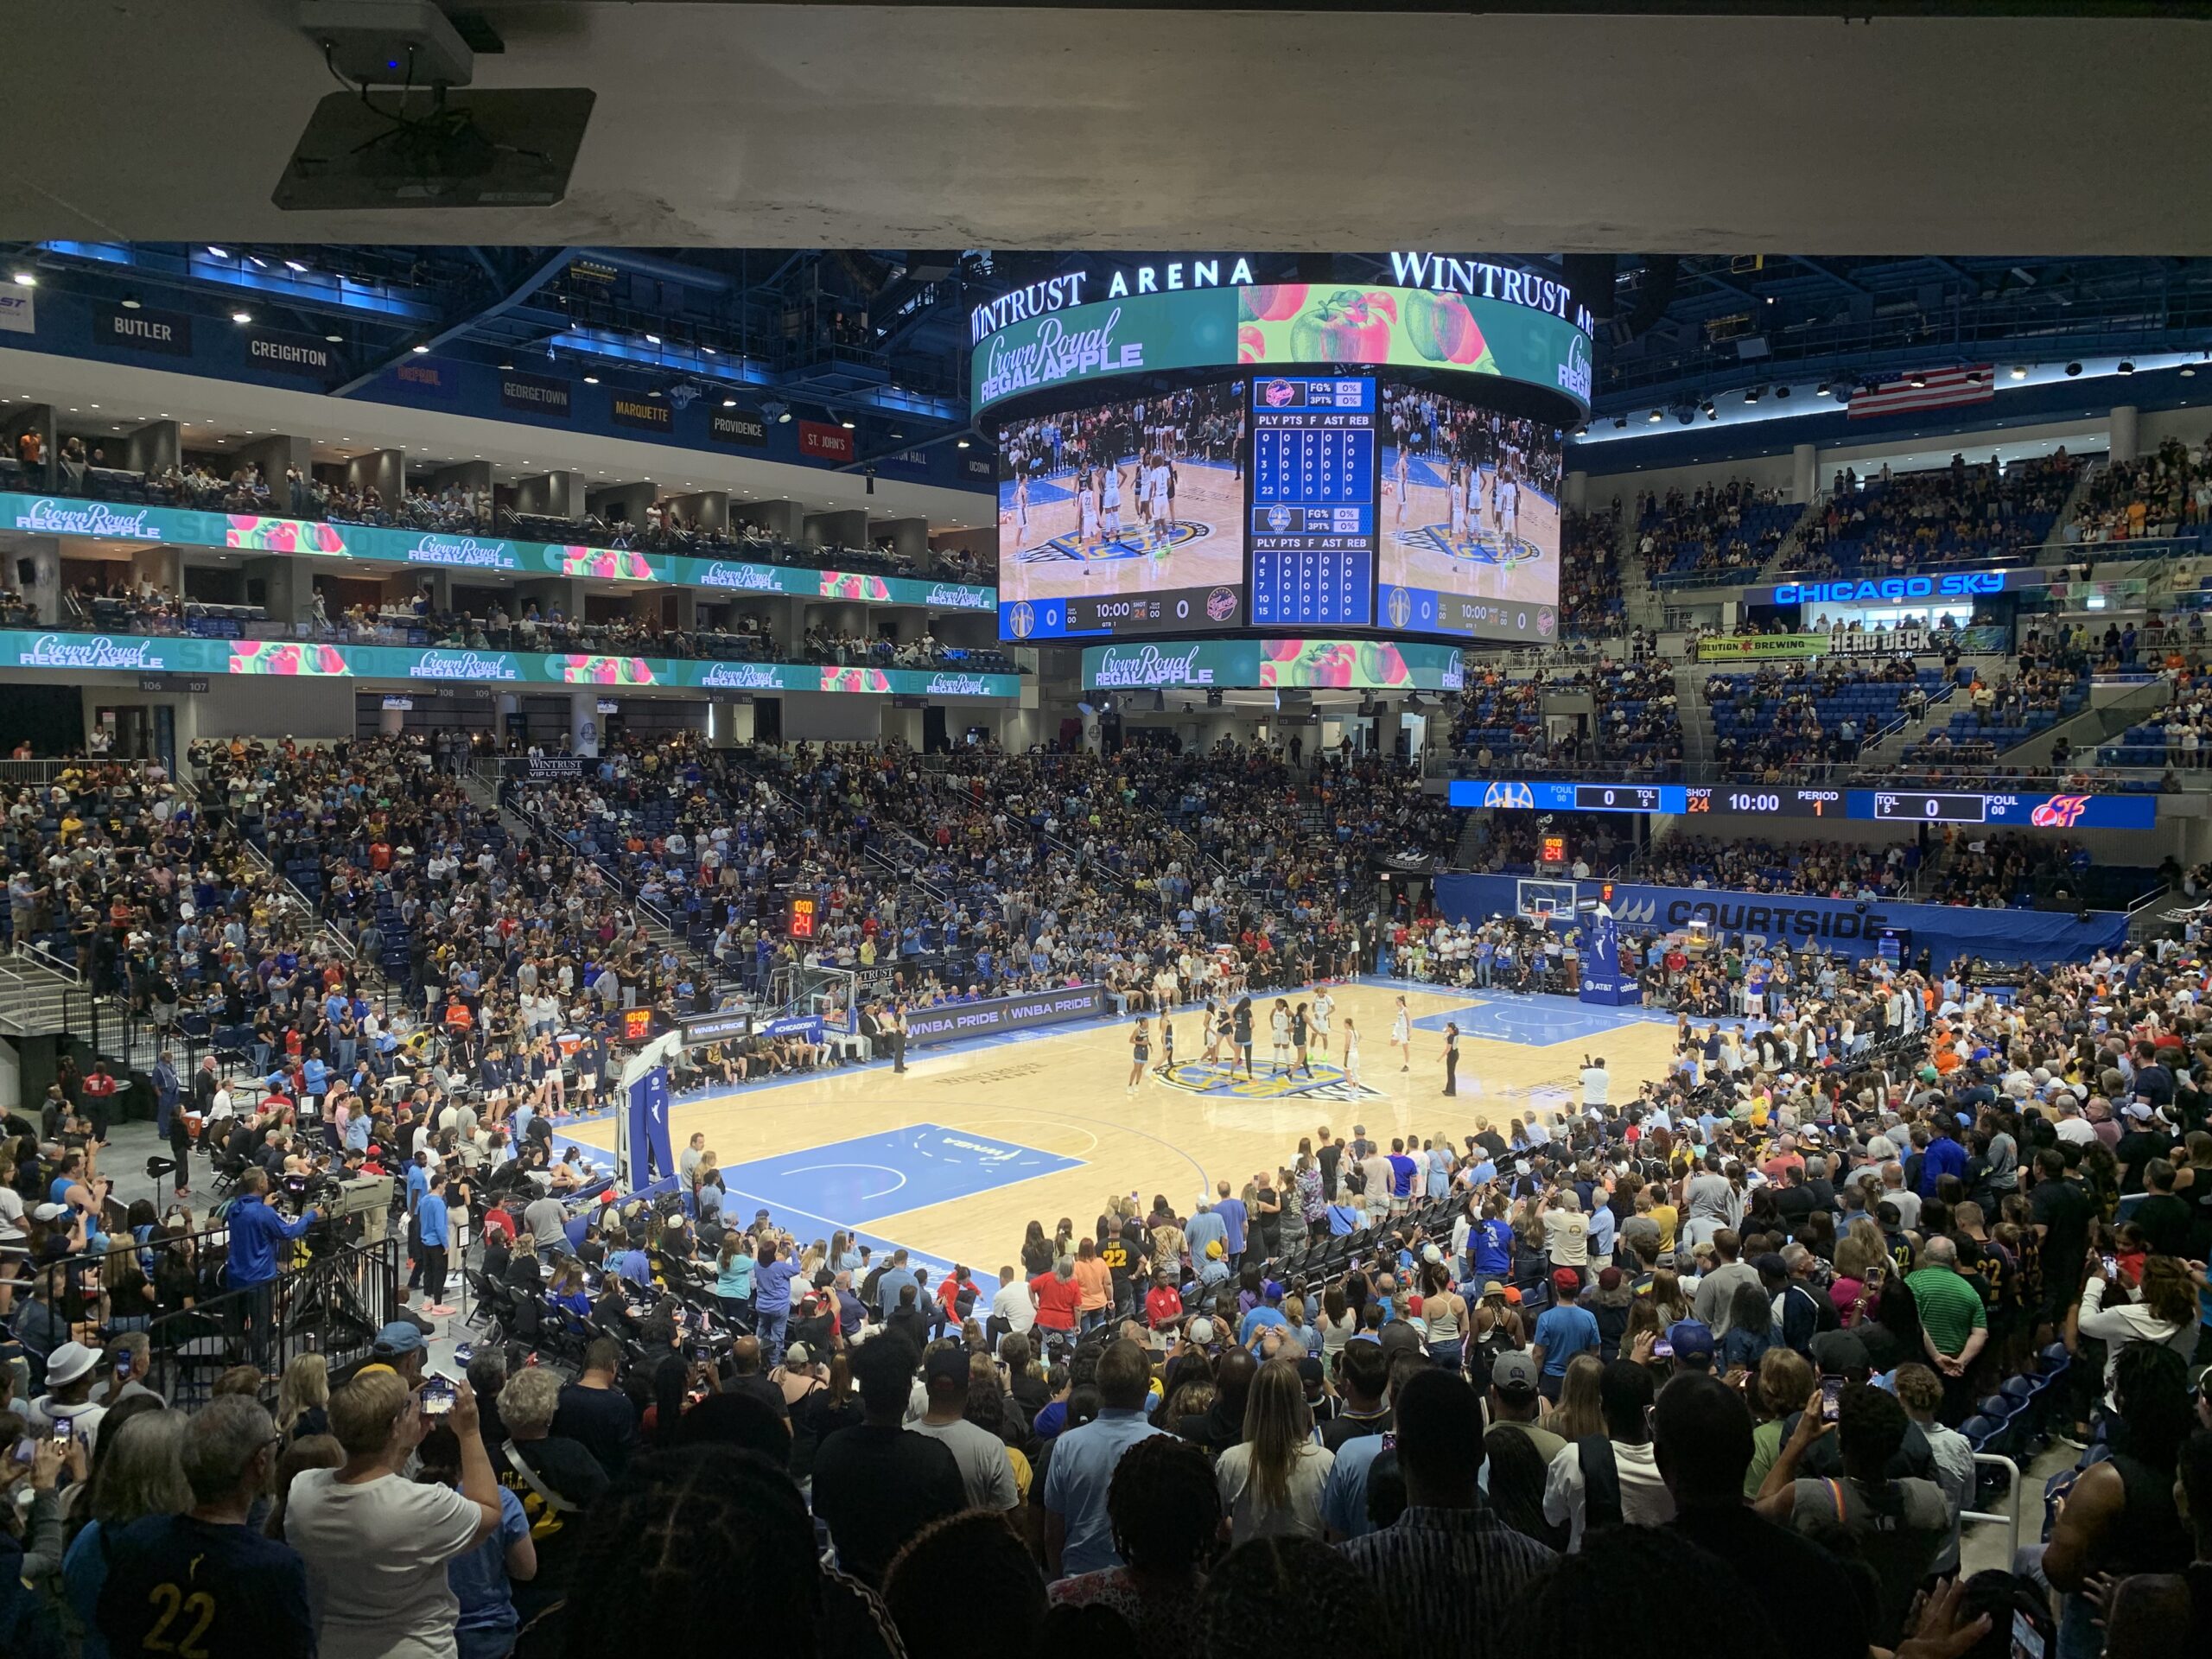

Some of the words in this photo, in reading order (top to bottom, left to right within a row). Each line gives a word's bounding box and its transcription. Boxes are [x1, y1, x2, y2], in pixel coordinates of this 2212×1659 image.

[1109, 257, 1253, 298] ARENA
[1390, 251, 1570, 319] WINTRUST
[114, 317, 171, 341] BUTLER
[988, 334, 1037, 379] Crown
[1031, 307, 1121, 377] Royal
[251, 340, 327, 366] CREIGHTON
[981, 364, 1040, 404] REGAL
[1042, 343, 1143, 382] APPLE
[504, 382, 567, 406] GEORGETOWN
[1310, 383, 1331, 392] FG%
[1343, 397, 1357, 405] 0%
[616, 401, 668, 422] MARQUETTE
[715, 417, 762, 437] PROVIDENCE
[1259, 416, 1278, 425] PLY
[1283, 416, 1302, 425] PTS
[1310, 416, 1316, 425] F
[1325, 416, 1344, 425] AST
[1350, 416, 1369, 425] REB
[808, 434, 819, 447] ST.
[822, 435, 845, 450] JOHN'S
[1262, 434, 1269, 442] 0
[911, 451, 926, 465] HALL
[969, 461, 990, 474] UCONN
[1262, 473, 1268, 481] 7
[29, 499, 87, 520] Crown
[86, 504, 148, 528] Royal
[1307, 510, 1329, 518] FG%
[16, 516, 91, 533] REGAL
[92, 523, 161, 538] APPLE
[418, 535, 461, 553] Crown
[459, 538, 505, 559] Royal
[1257, 538, 1276, 547] PLY
[1281, 538, 1300, 547] PTS
[1308, 538, 1314, 547] F
[1322, 538, 1342, 547] AST
[1347, 538, 1367, 547] REB
[409, 550, 462, 563] REGAL
[464, 555, 514, 568] APPLE
[709, 562, 742, 578] Crown
[740, 565, 775, 583] Royal
[701, 575, 743, 587] REGAL
[744, 579, 783, 591] APPLE
[1775, 577, 1932, 604] CHICAGO
[1940, 573, 2005, 594] SKY
[926, 596, 959, 605] REGAL
[960, 599, 989, 608] APPLE
[1096, 602, 1129, 617] 10:00
[1135, 608, 1145, 618] 24
[1176, 600, 1189, 619] 0
[1046, 609, 1057, 626] 0
[1421, 601, 1430, 620] 0
[1462, 604, 1486, 620] 10:00
[1500, 617, 1507, 626] 00
[1518, 613, 1526, 629] 0
[1882, 629, 1931, 650] DECK
[33, 635, 92, 657] Crown
[91, 636, 149, 662] Royal
[20, 653, 92, 666] REGAL
[93, 655, 164, 668] APPLE
[420, 651, 464, 669] Crown
[461, 652, 503, 674] Royal
[1103, 647, 1140, 672] Crown
[1137, 645, 1198, 678] Royal
[410, 667, 465, 677] REGAL
[465, 668, 515, 679] APPLE
[709, 664, 747, 679] Crown
[743, 664, 776, 684] Royal
[1096, 672, 1142, 685] REGAL
[1144, 670, 1213, 683] APPLE
[143, 682, 161, 690] 106
[189, 683, 207, 691] 107
[702, 677, 747, 686] REGAL
[745, 679, 784, 688] APPLE
[529, 760, 582, 768] WINTRUST
[1605, 791, 1614, 805] 0
[1637, 790, 1655, 798] TOL
[1686, 788, 1712, 797] SHOT
[1797, 791, 1839, 801] PERIOD
[1878, 796, 1899, 805] TOL
[1986, 796, 2018, 805] FOUL
[1688, 798, 1709, 812] 24
[1729, 794, 1779, 810] 10:00
[1814, 800, 1822, 816] 1
[1925, 799, 1938, 817] 0
[1992, 805, 2005, 815] 00
[1545, 848, 1561, 860] 24
[795, 900, 812, 913] 10:00
[794, 914, 811, 935] 24
[1668, 901, 1887, 940] COURTSIDE
[1594, 982, 1613, 992] AT&T
[1011, 1004, 1052, 1020] WNBA
[1056, 997, 1091, 1012] PRIDE
[626, 1012, 648, 1022] 10:00
[908, 1019, 953, 1035] WNBA
[957, 1012, 998, 1027] PRIDE
[628, 1024, 644, 1037] 24
[721, 1021, 744, 1031] PRIDE
[775, 1021, 817, 1033] @CHICAGOSKY
[1103, 1249, 1127, 1268] 22
[1895, 1247, 1910, 1267] 22
[143, 1583, 215, 1659] 22
